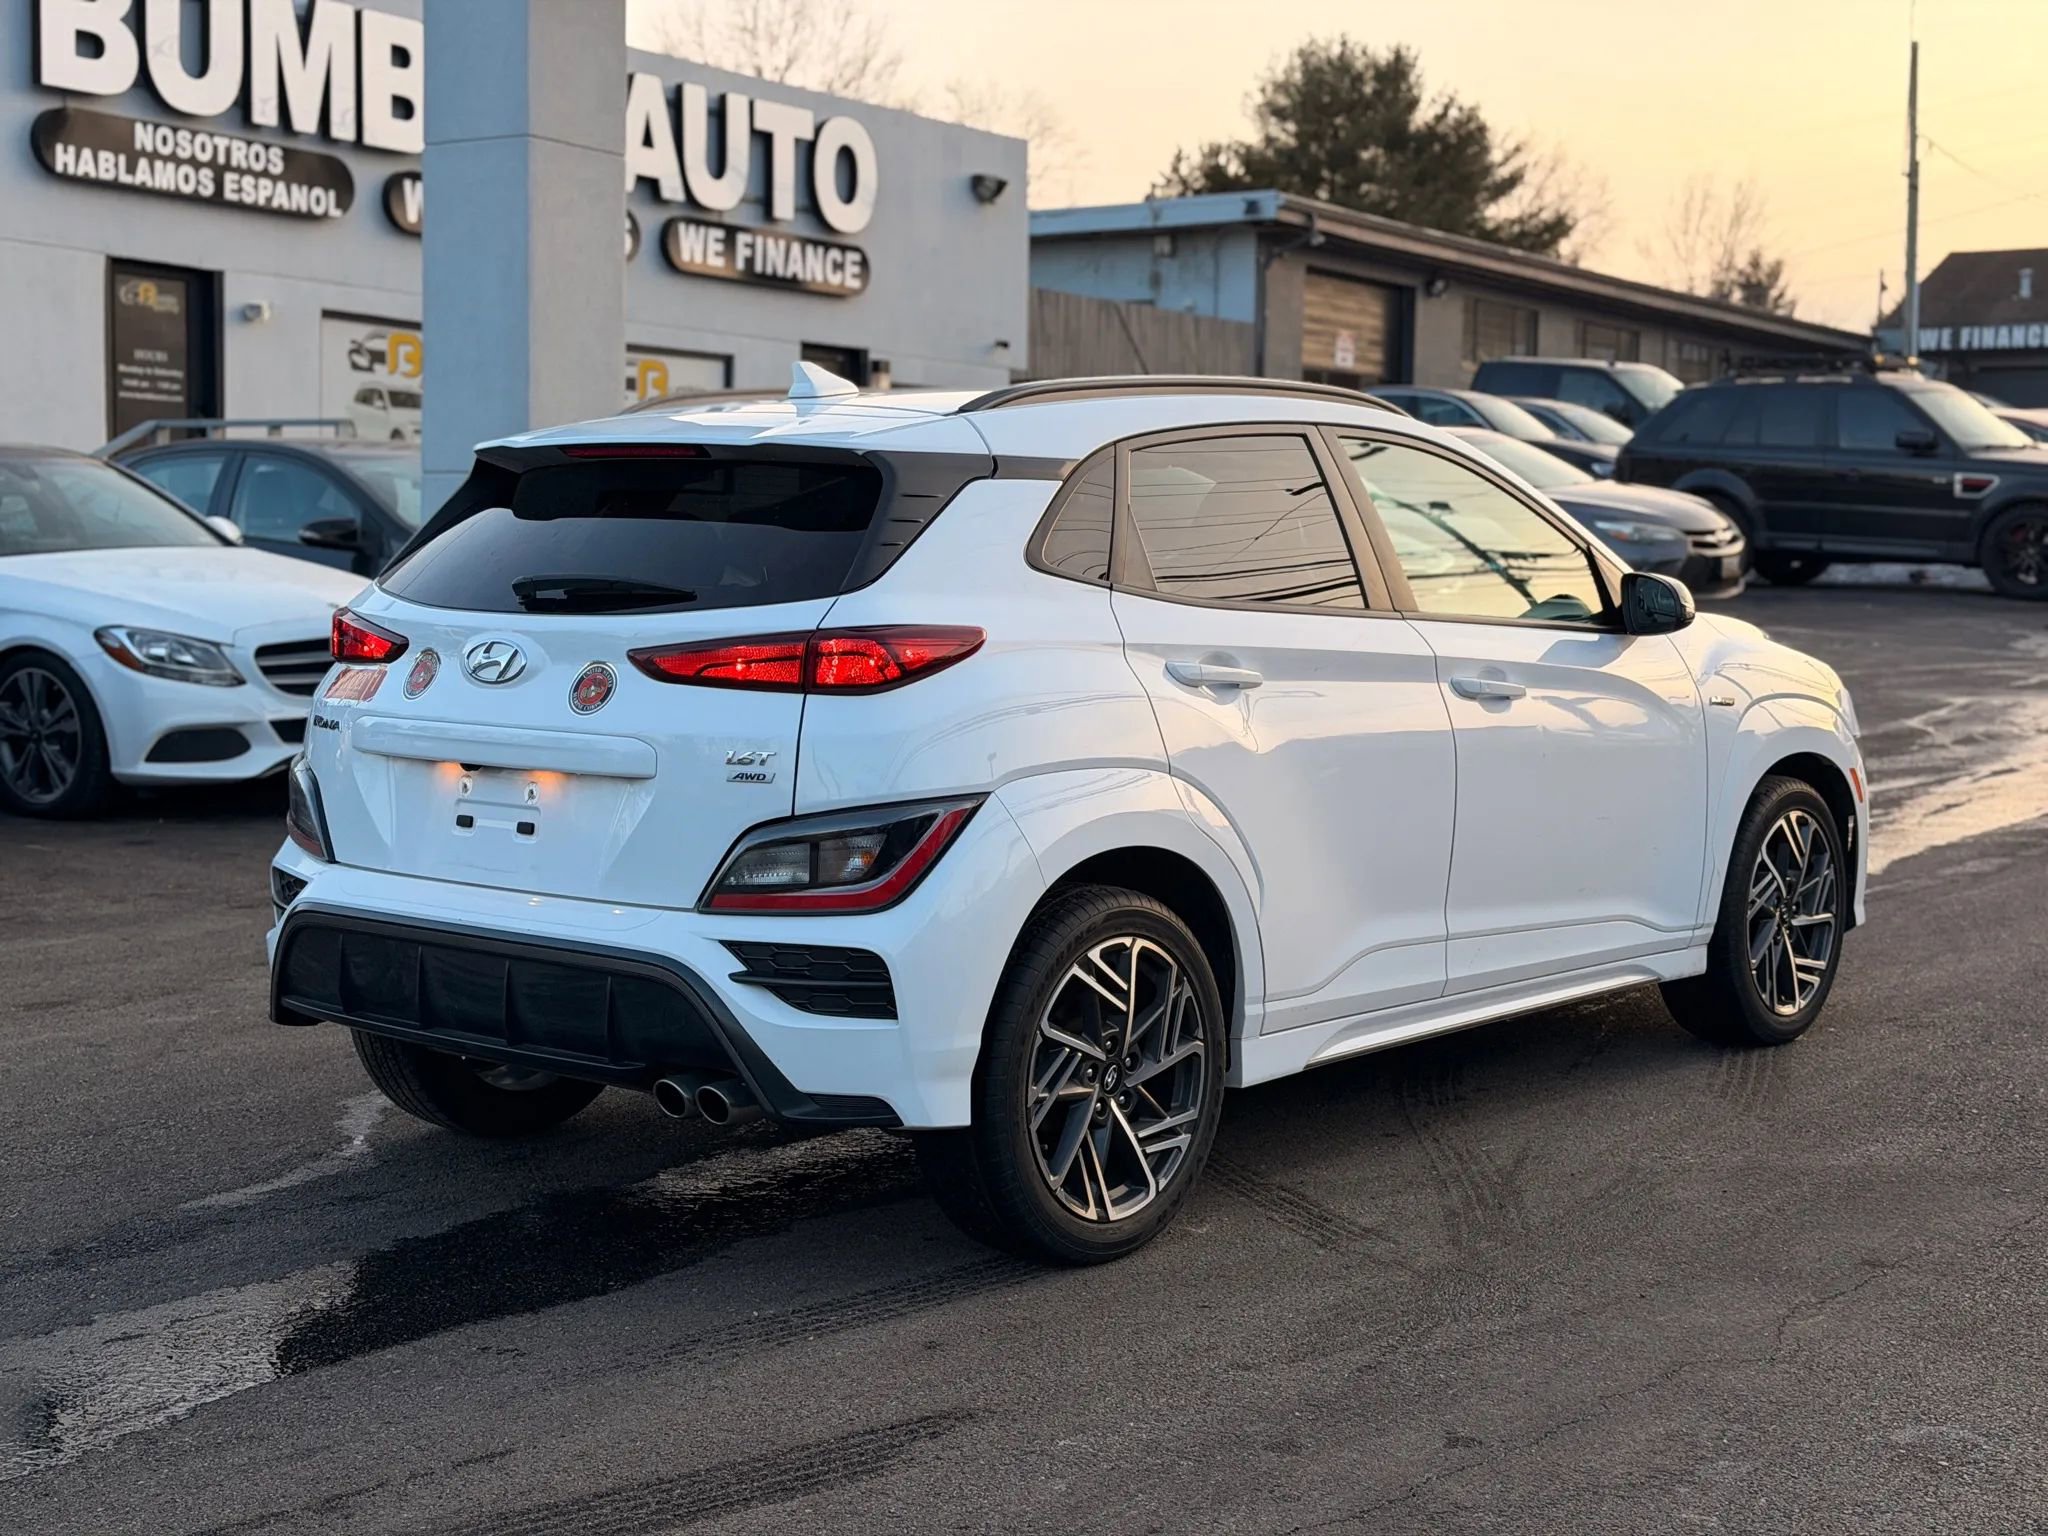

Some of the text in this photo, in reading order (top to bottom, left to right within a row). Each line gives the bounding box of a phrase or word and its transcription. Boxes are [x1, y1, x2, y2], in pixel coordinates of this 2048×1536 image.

[134, 122, 284, 176] NOSOTROS
[626, 73, 878, 233] AUTO
[54, 143, 216, 198] HABLAMOS
[223, 170, 343, 218] ESPANOL
[677, 222, 726, 268] WE
[735, 231, 863, 289] FINANCE
[1919, 327, 1952, 350] WE
[732, 772, 767, 781] AWD
